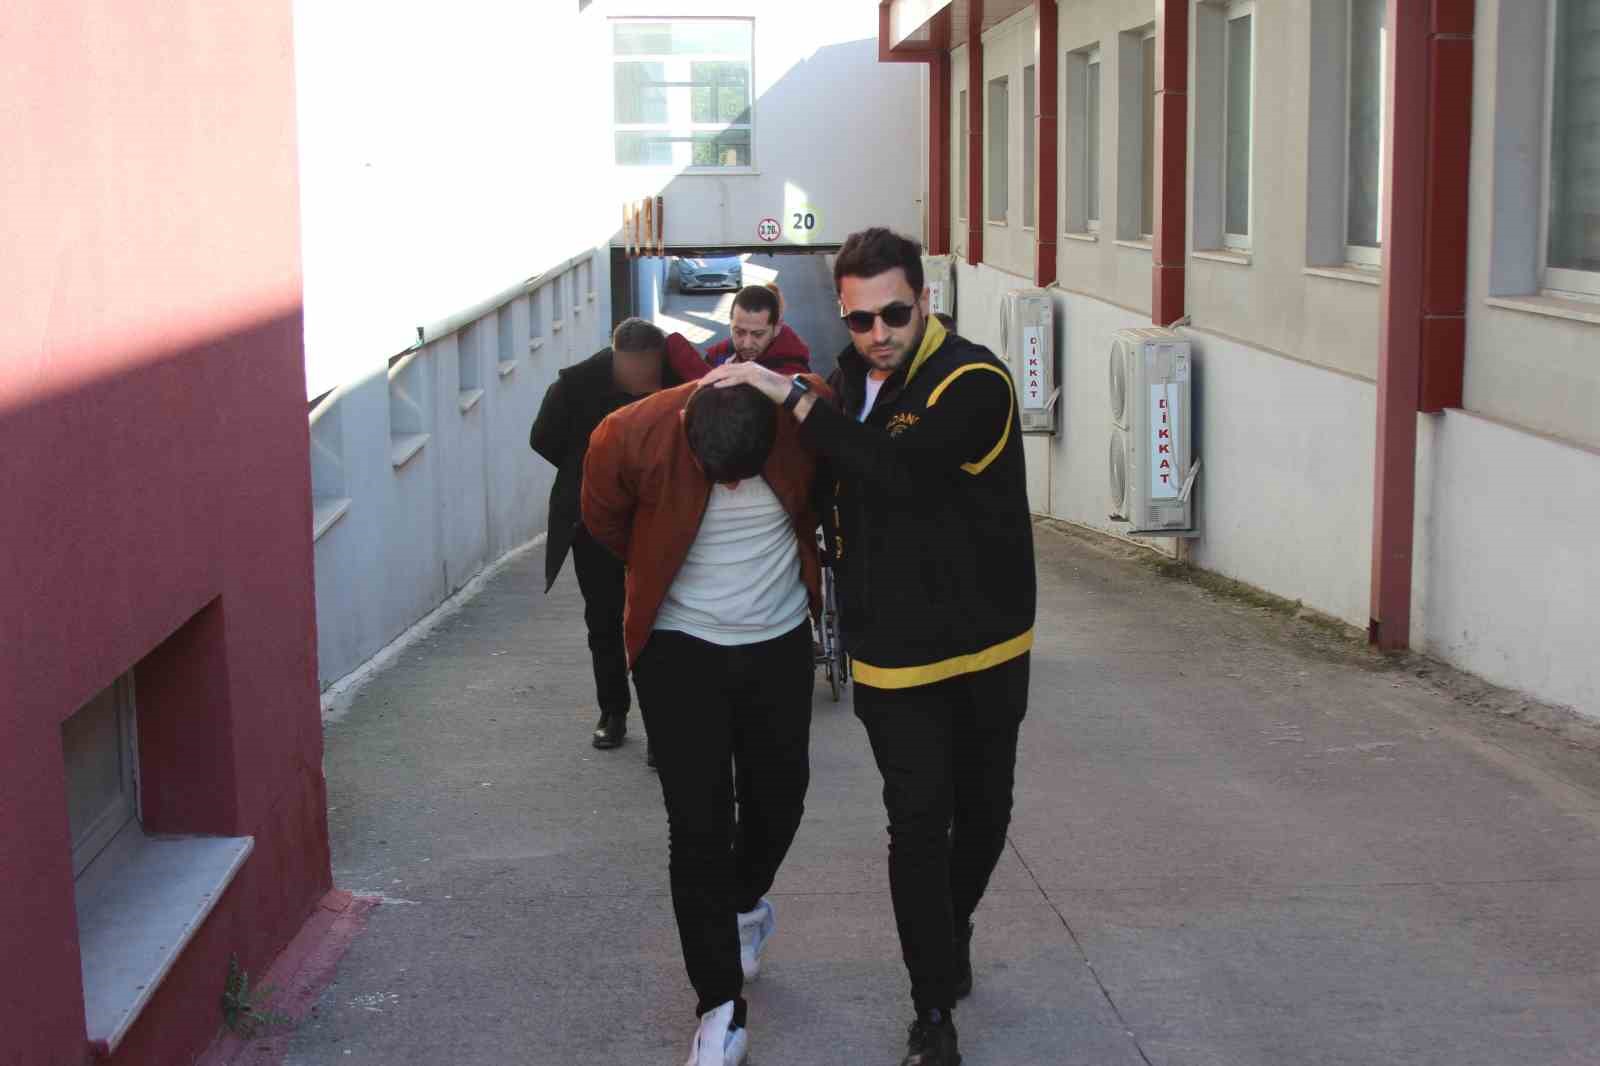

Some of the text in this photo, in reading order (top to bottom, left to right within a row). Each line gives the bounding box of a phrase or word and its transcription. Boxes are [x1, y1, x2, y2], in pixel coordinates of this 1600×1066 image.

[792, 212, 815, 230] 20
[1029, 336, 1039, 399] DİKKAT
[1158, 399, 1170, 484] DİKKAT
